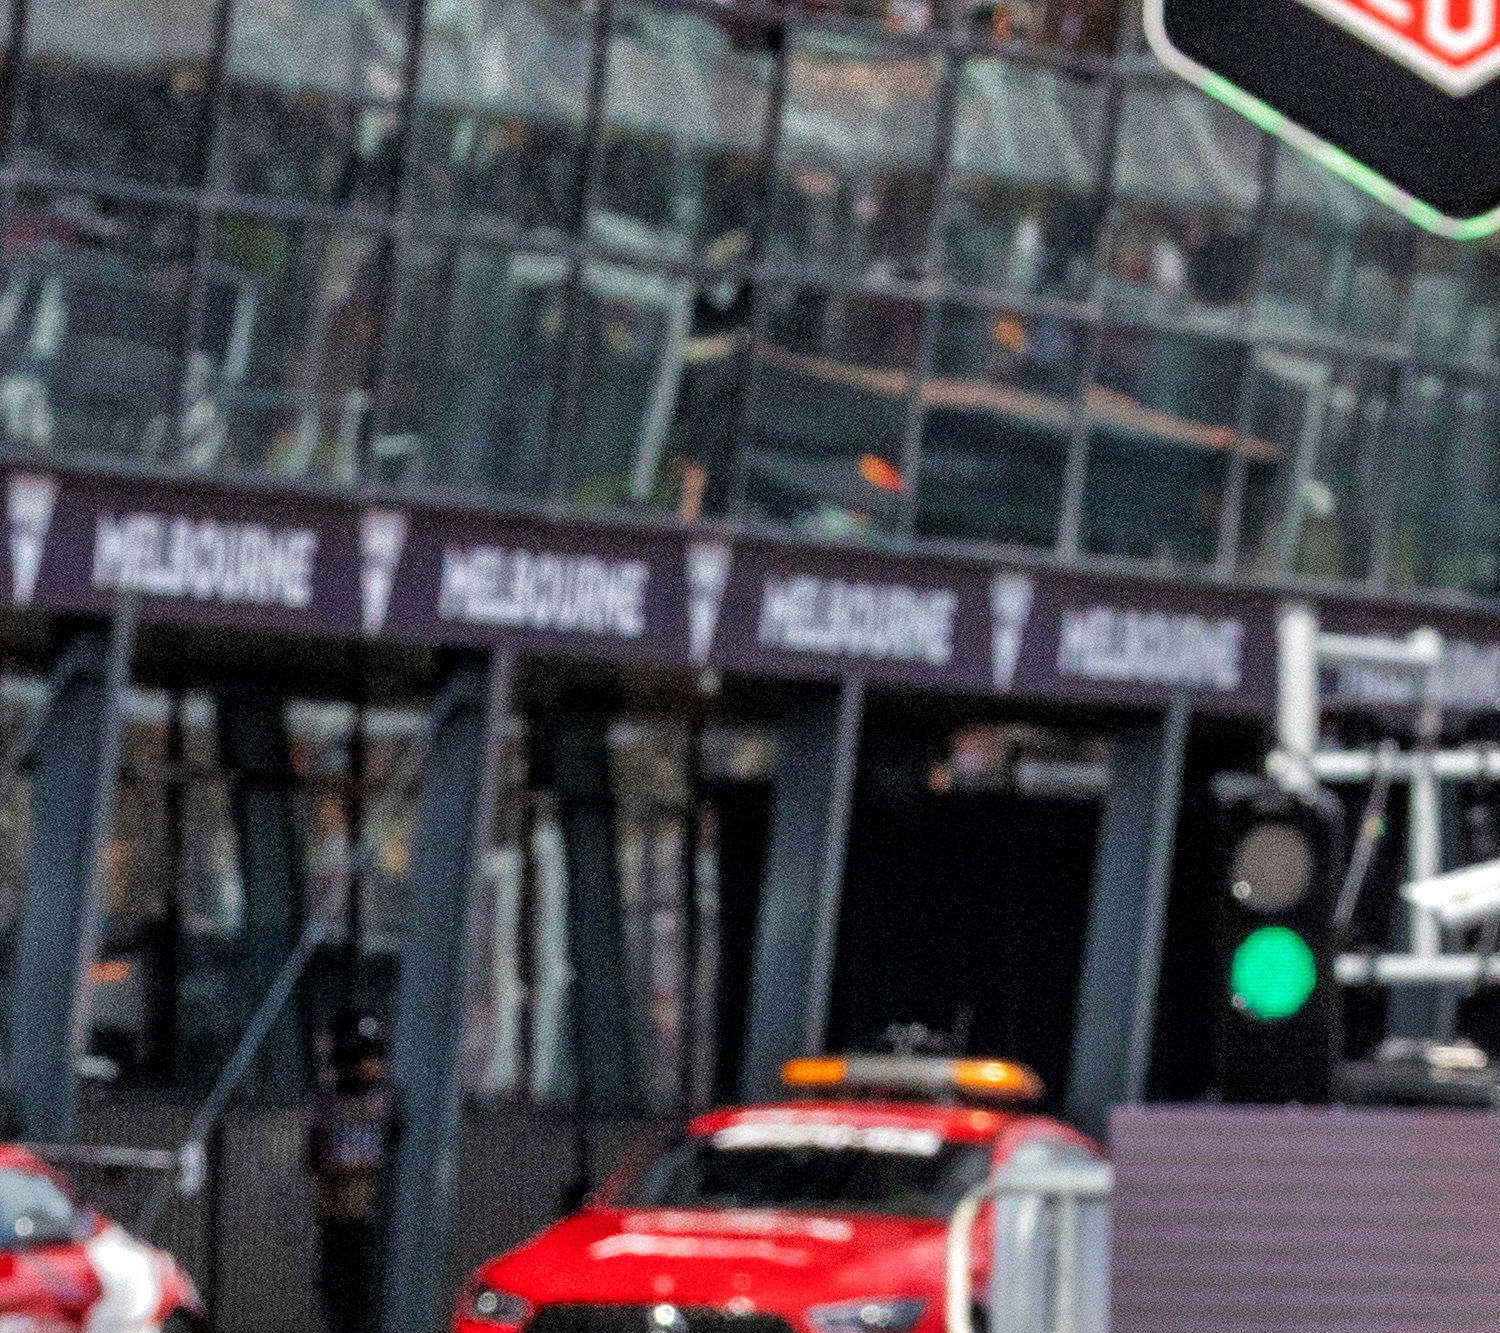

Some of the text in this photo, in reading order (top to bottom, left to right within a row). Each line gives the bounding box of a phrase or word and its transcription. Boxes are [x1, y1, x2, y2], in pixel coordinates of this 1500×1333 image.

[90, 511, 316, 607] MELBOURNE
[437, 547, 651, 640] MELBOURNE
[757, 573, 958, 667] MELBOURNE
[1058, 606, 1243, 690] MELBOURNE
